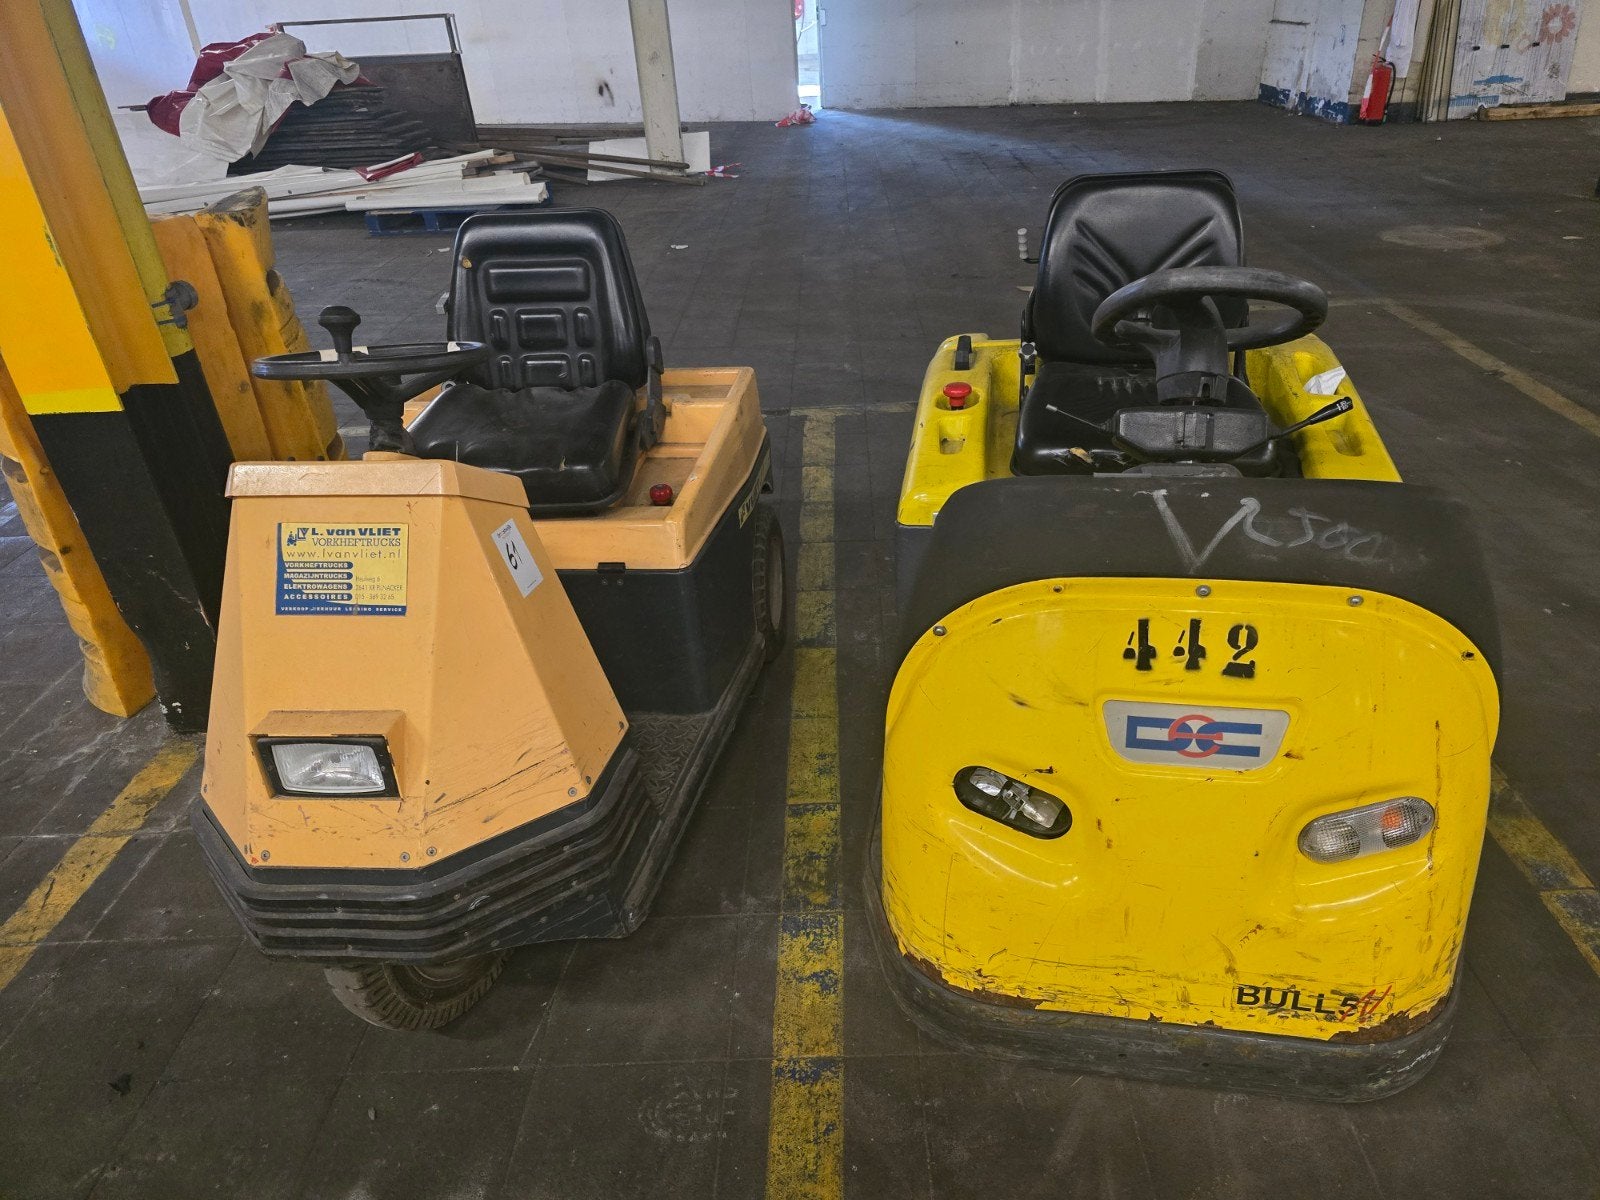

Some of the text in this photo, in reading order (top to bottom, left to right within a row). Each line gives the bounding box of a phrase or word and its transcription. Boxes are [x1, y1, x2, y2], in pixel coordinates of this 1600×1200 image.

[311, 527, 401, 536] L. van VLIET
[311, 537, 401, 547] VORKHEFTRUCKS
[286, 548, 401, 559] www.lvanvliet.nl
[1122, 617, 1257, 679] 442
